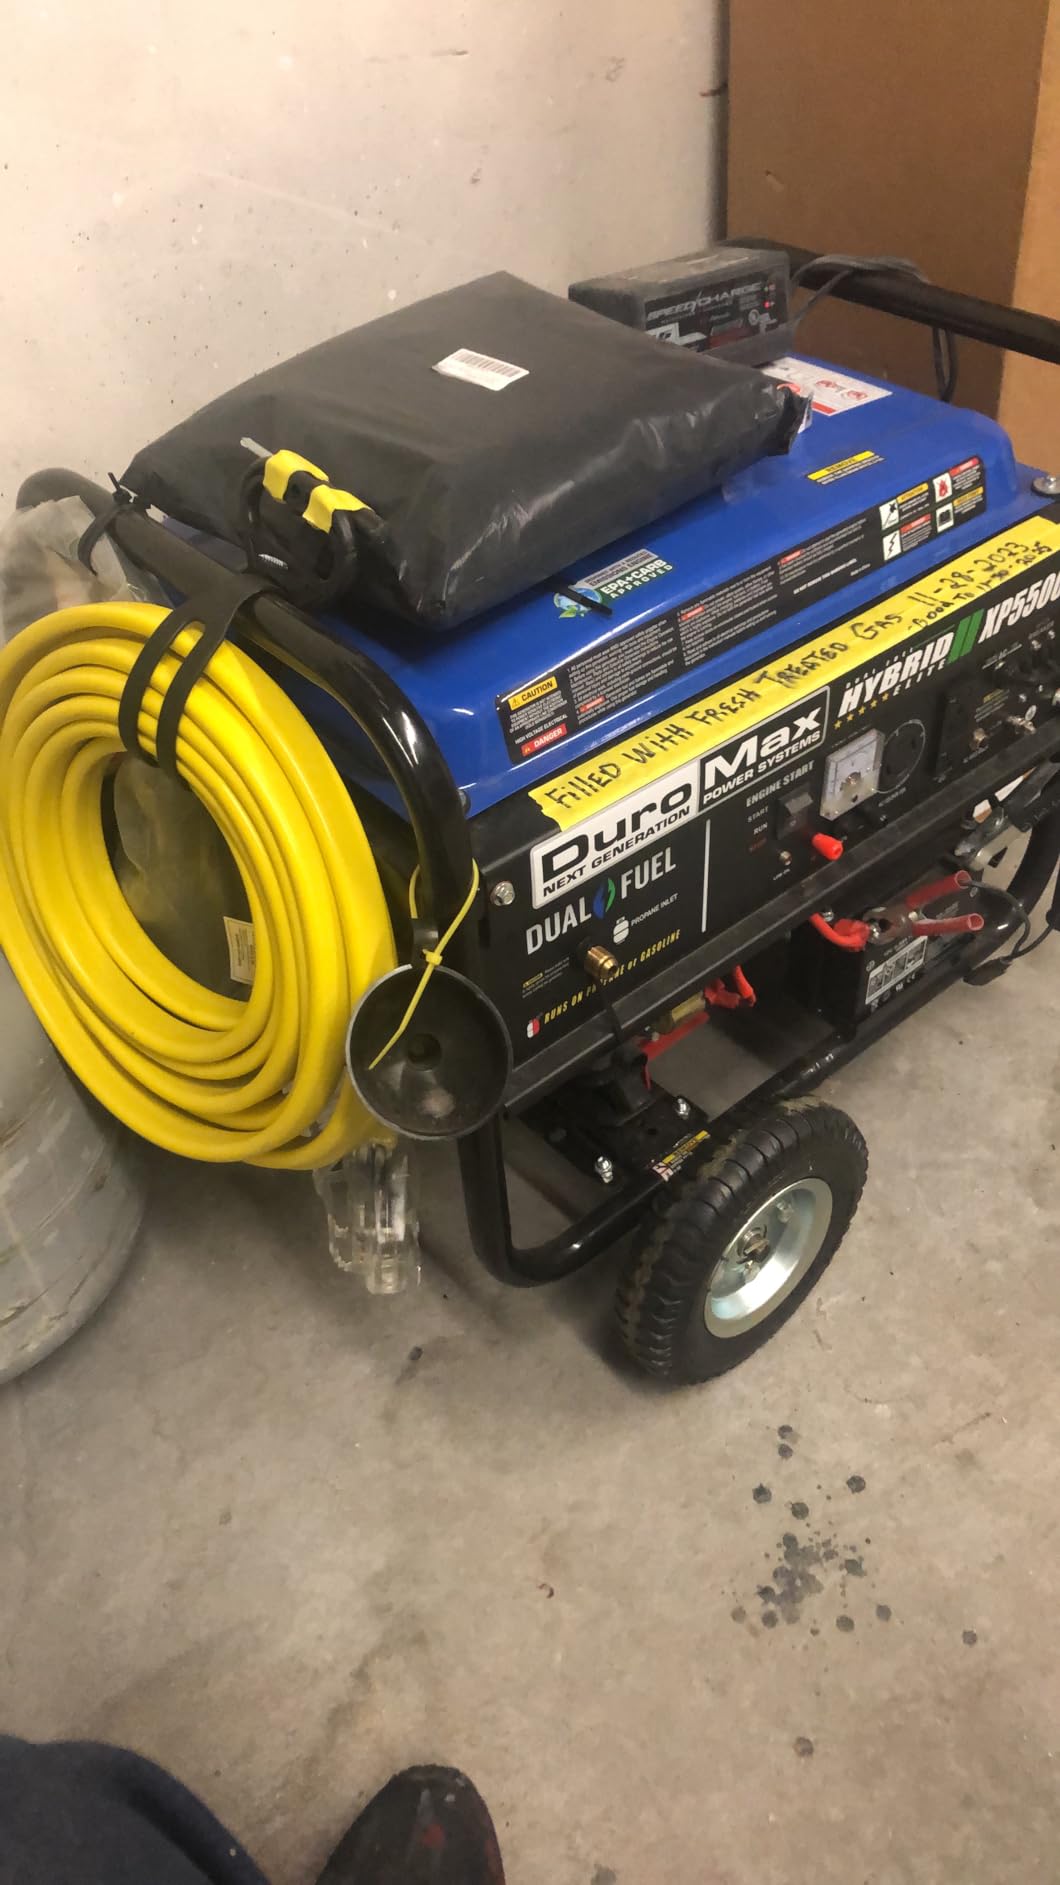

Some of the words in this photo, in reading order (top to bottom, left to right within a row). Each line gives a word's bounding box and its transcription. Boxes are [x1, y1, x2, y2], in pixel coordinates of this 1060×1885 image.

[600, 559, 667, 594] EPA+CARB
[610, 564, 673, 599] APPROVED
[684, 688, 761, 726] FRESH
[753, 642, 849, 688] TREATED
[851, 612, 903, 640] GAS
[837, 632, 954, 718] HYBRID
[893, 659, 946, 696] ELITE
[521, 681, 553, 702] CAUTION
[533, 728, 563, 748] DANGER
[703, 769, 754, 805] POWER
[757, 730, 821, 773] SYSTEMS
[746, 782, 782, 807] ENGINE
[783, 760, 815, 785] START
[542, 783, 693, 884] Duro
[704, 706, 822, 790] Max
[747, 805, 769, 823] START
[753, 822, 768, 835] RUN
[543, 867, 588, 898] NEXT
[591, 805, 691, 869] GENERATION
[526, 897, 592, 955] DUAL
[621, 847, 676, 900] FUEL
[631, 903, 660, 927] PROPANE
[660, 893, 679, 908] INLET
[544, 1001, 568, 1024] RUNS
[571, 991, 583, 1007] ON
[640, 929, 681, 962] GASOLINE
